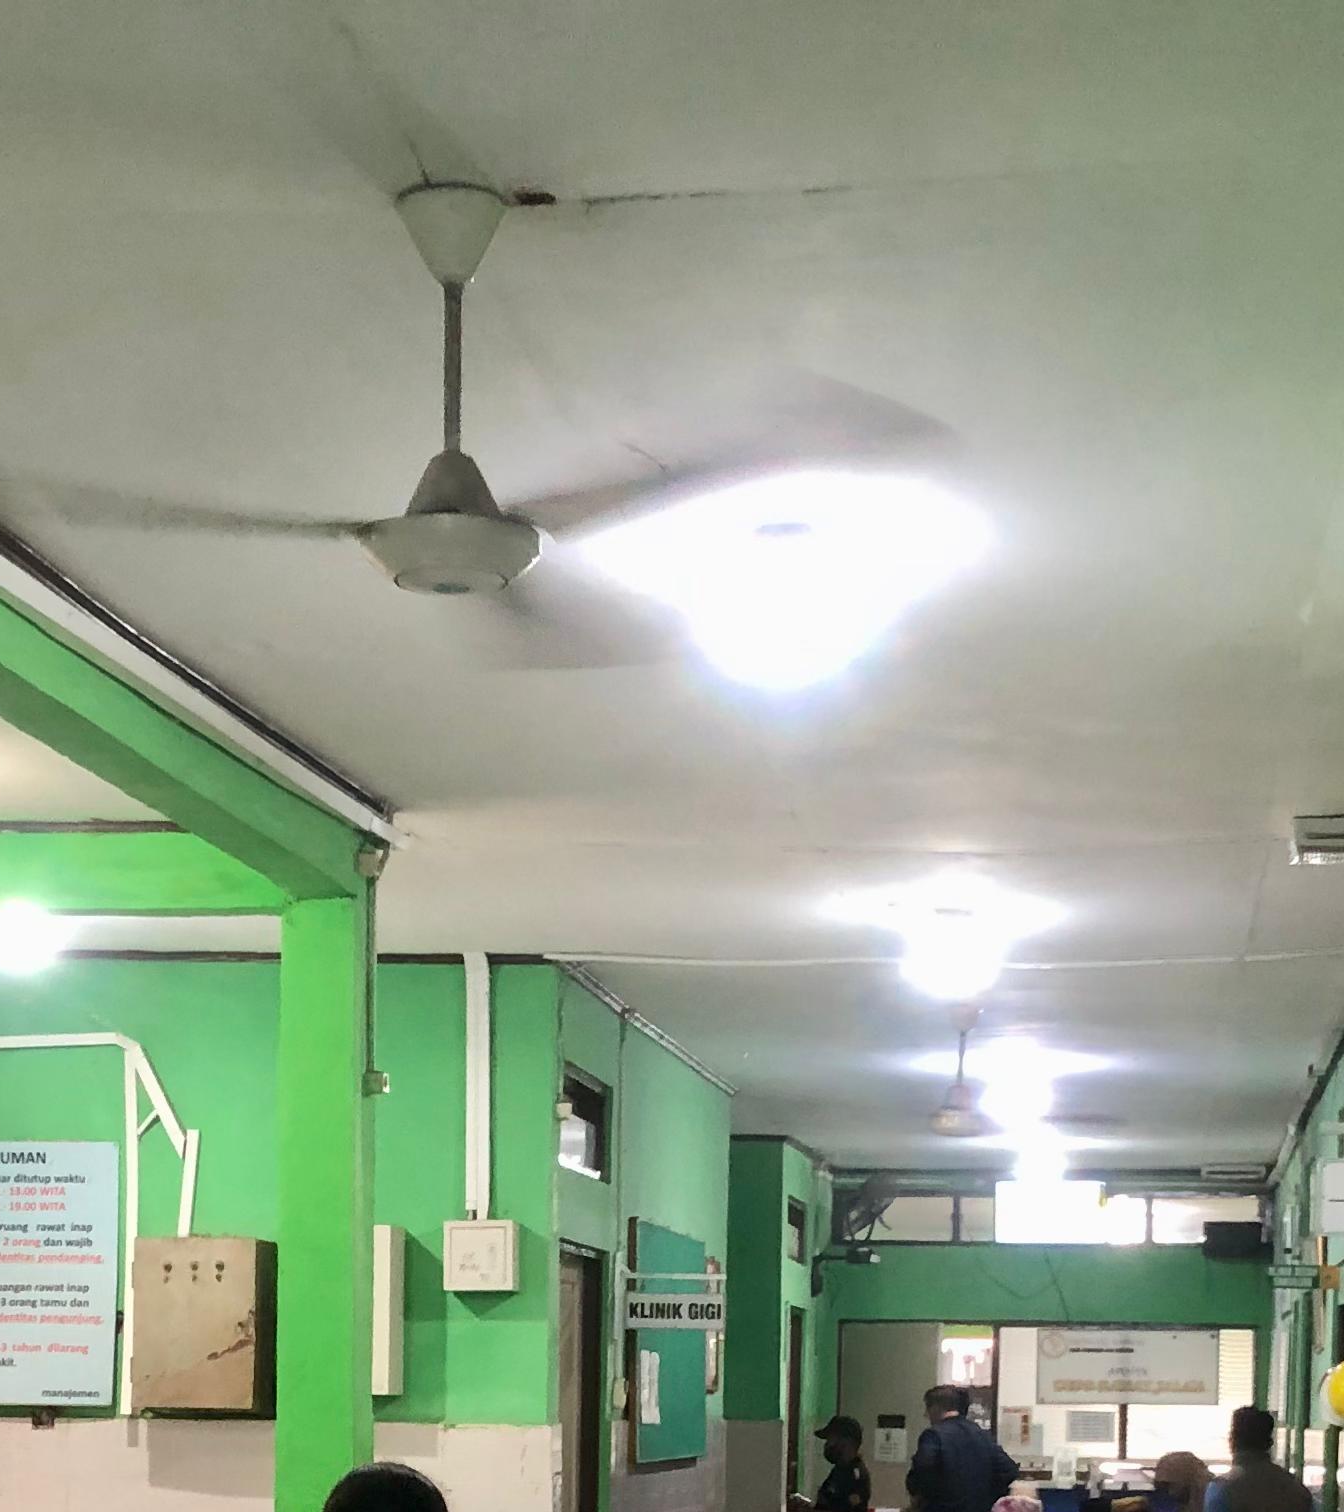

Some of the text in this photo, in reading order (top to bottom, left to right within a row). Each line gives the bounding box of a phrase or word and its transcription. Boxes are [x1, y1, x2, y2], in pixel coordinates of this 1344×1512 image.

[14, 1174, 51, 1184] ditutup
[54, 1174, 86, 1183] waktu
[40, 1187, 66, 1196] WITA
[40, 1202, 66, 1211] WITA
[0, 1224, 28, 1232] ruang
[36, 1223, 65, 1231] rawat
[71, 1223, 92, 1233] inap
[12, 1239, 41, 1248] orang
[44, 1237, 62, 1246] dan
[65, 1237, 92, 1248] wajib
[35, 1284, 64, 1292] rawat
[67, 1284, 89, 1294] inap
[9, 1299, 37, 1309] orang
[40, 1299, 67, 1307] tamu
[70, 1298, 89, 1307] dan
[629, 1302, 721, 1320] KLINIK GIGI
[42, 1390, 100, 1399] manajemen
